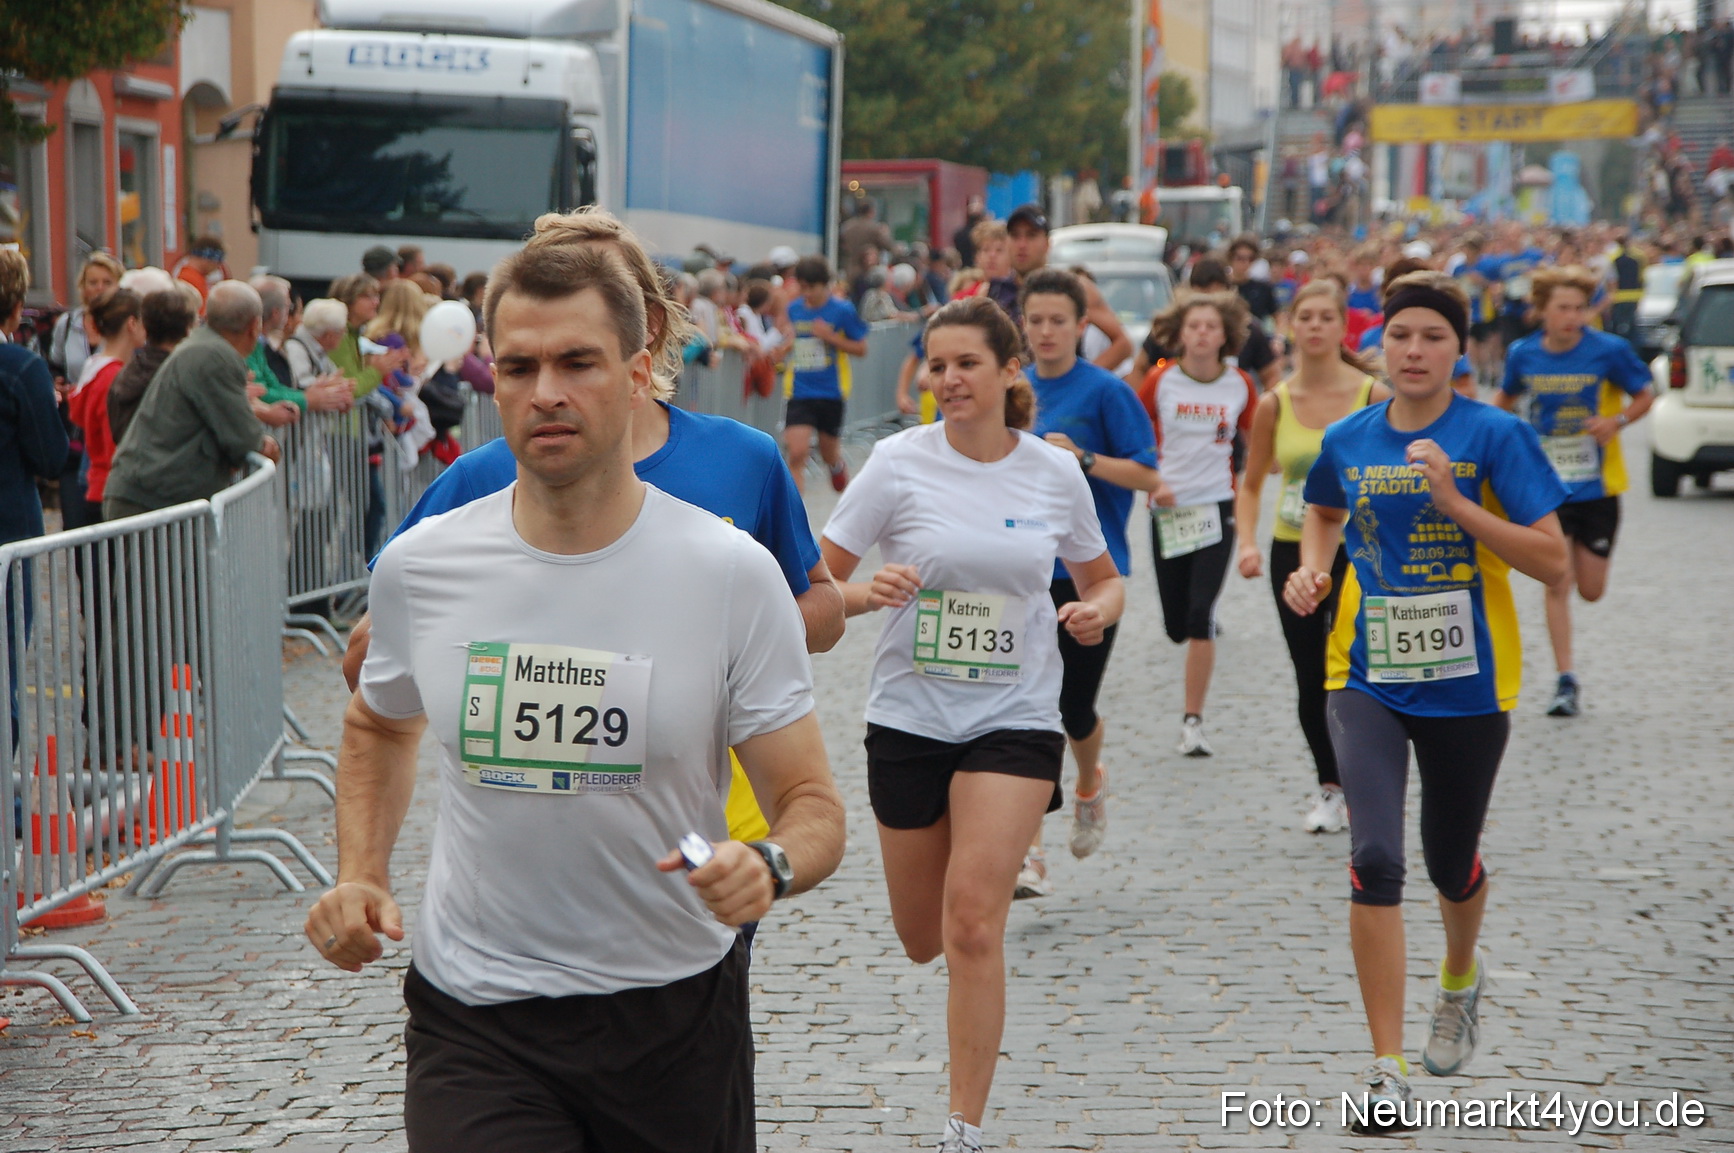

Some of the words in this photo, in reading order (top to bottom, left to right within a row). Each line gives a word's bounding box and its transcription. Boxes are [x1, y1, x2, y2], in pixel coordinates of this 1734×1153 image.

[1457, 109, 1546, 131] START
[1345, 466, 1363, 481] 10.
[1359, 479, 1432, 495] STADTLA
[947, 598, 990, 617] Katrin
[1391, 603, 1459, 621] Katharina
[921, 622, 928, 634] S
[947, 626, 1015, 654] 5133
[1371, 629, 1378, 642] S
[1397, 625, 1465, 654] 5190
[515, 654, 606, 687] Matthes
[469, 696, 481, 716] S
[514, 701, 629, 747] 5129
[480, 769, 525, 783] BOCK
[573, 772, 641, 785] PFLEIDERER
